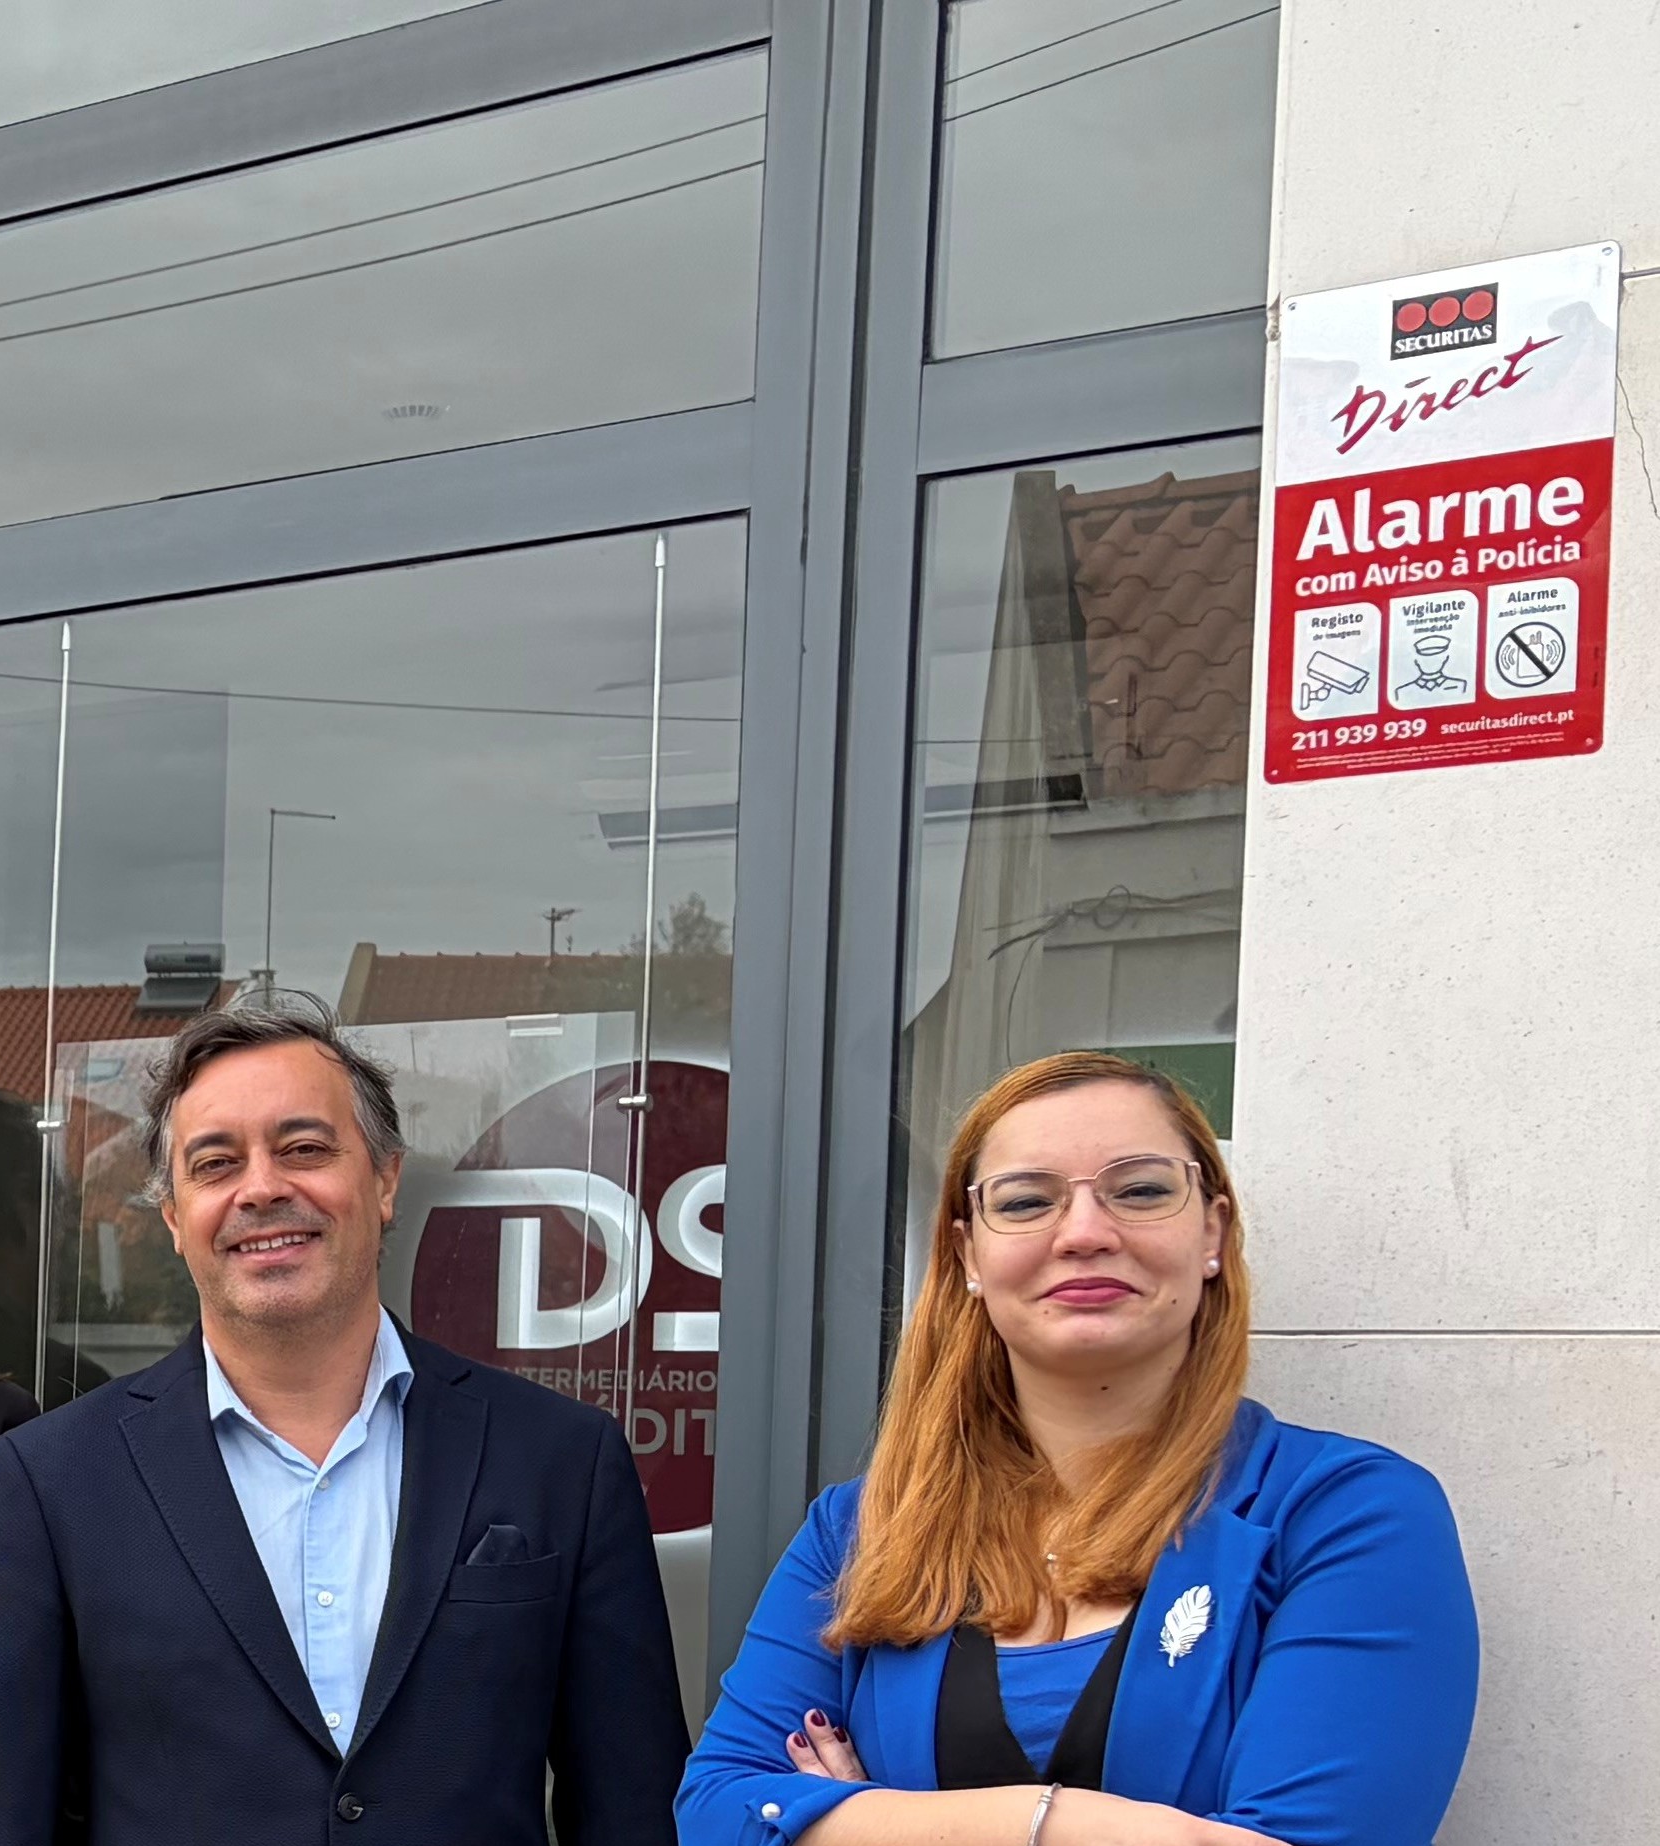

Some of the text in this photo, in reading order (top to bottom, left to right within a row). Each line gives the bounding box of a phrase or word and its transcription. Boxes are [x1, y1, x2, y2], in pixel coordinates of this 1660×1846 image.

[1395, 323, 1493, 354] SECURITAS
[1331, 335, 1564, 455] Direct
[1295, 476, 1585, 561] Alarme
[1295, 535, 1581, 597] com Aviso à Polícia
[1402, 598, 1466, 618] Vigilante
[1507, 587, 1558, 604] Alarme
[1311, 611, 1364, 629] Registo
[1291, 718, 1427, 750] 211 939 939
[1440, 708, 1575, 735] securitasdirect.pt
